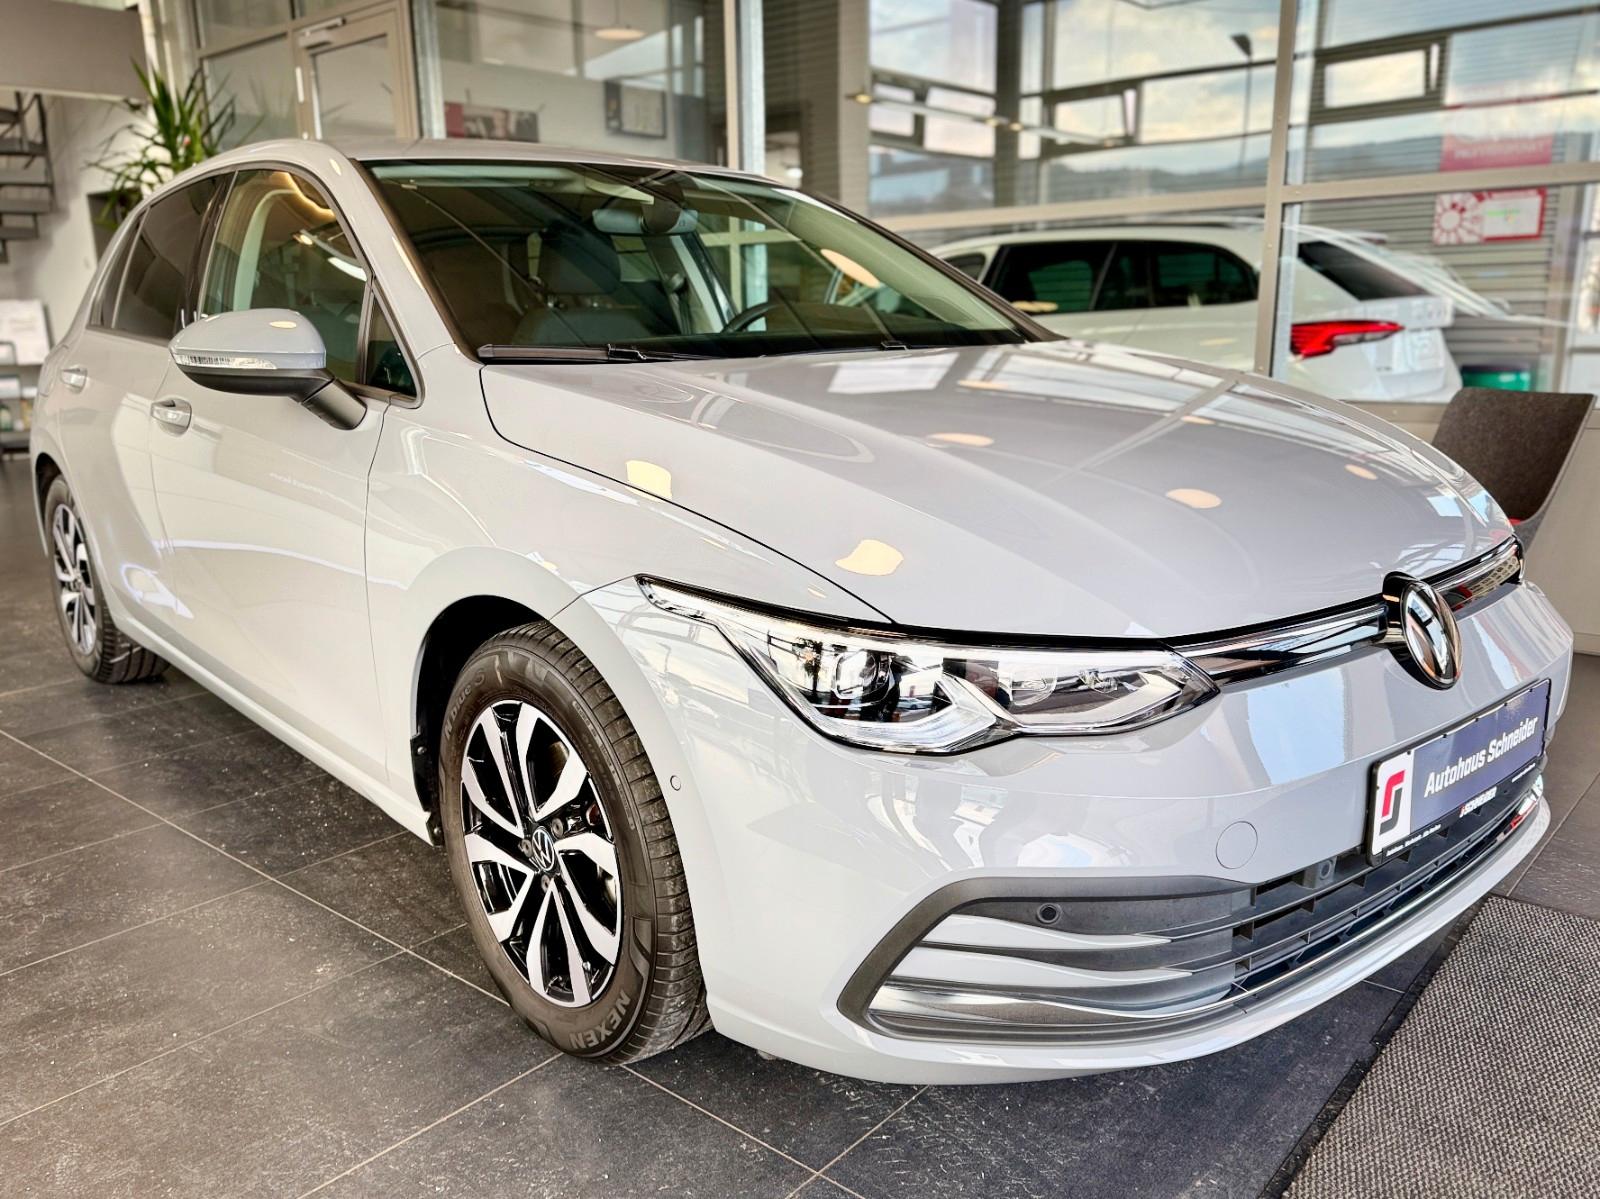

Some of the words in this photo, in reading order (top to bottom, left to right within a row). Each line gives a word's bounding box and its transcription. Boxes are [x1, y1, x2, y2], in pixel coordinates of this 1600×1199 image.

[1424, 750, 1486, 798] Autohaus
[1487, 716, 1539, 763] Schneider
[568, 990, 631, 1049] NEXEN
